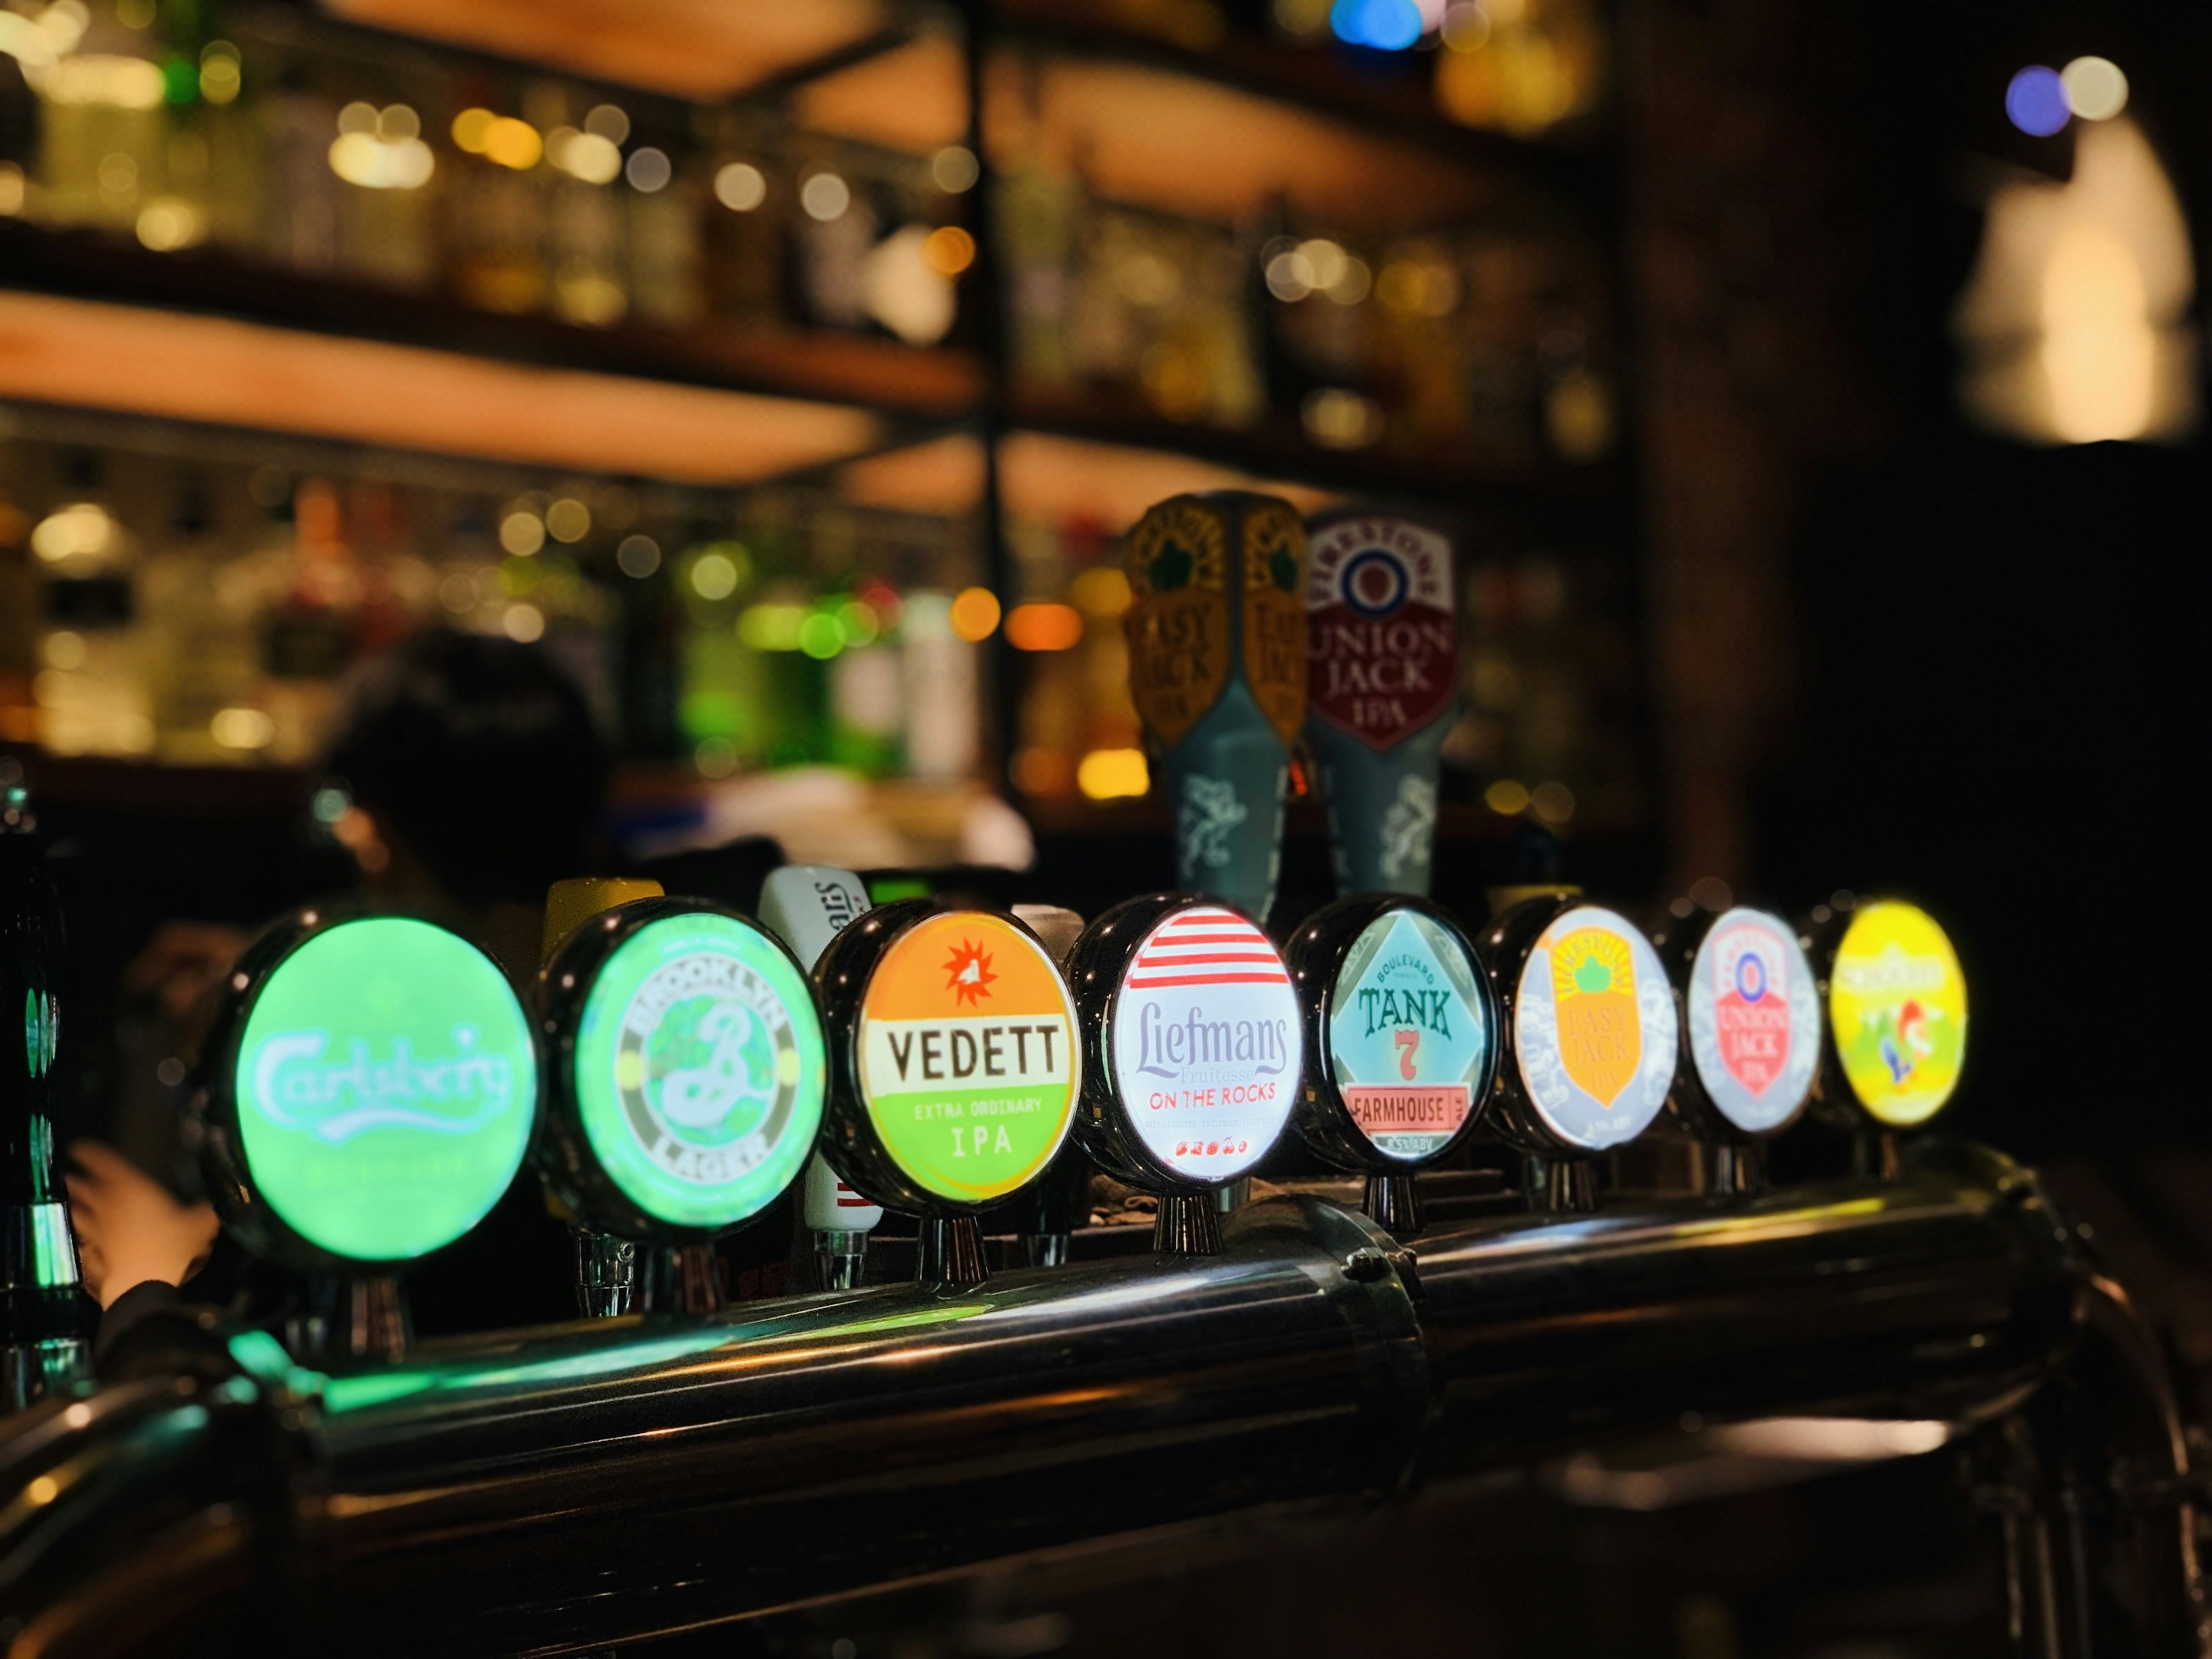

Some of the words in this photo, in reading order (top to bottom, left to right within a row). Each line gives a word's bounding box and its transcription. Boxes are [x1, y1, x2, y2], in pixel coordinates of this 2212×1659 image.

[1308, 620, 1452, 661] UNION
[1325, 655, 1434, 700] JACK
[1352, 697, 1409, 728] IPA
[1377, 954, 1434, 985] BOULEVARD
[626, 956, 788, 1038] BROOKLYN
[1358, 988, 1452, 1041] TANK
[1568, 1005, 1628, 1036] EASY
[887, 1025, 1059, 1082] VEDETT
[1135, 1002, 1287, 1079] Liefmans
[1395, 1029, 1420, 1081] 7
[1572, 1033, 1630, 1069] JACK
[1181, 1066, 1255, 1084] Fruitesse
[914, 1102, 962, 1121] EXTRA
[971, 1098, 1043, 1118] ORDINARY
[1149, 1091, 1177, 1110] ON
[1183, 1088, 1215, 1108] THE
[1221, 1081, 1276, 1105] ROCKS
[1354, 1097, 1444, 1122] FARMHOUSE
[651, 1132, 769, 1183] LAGER
[951, 1124, 1012, 1157] IPA
